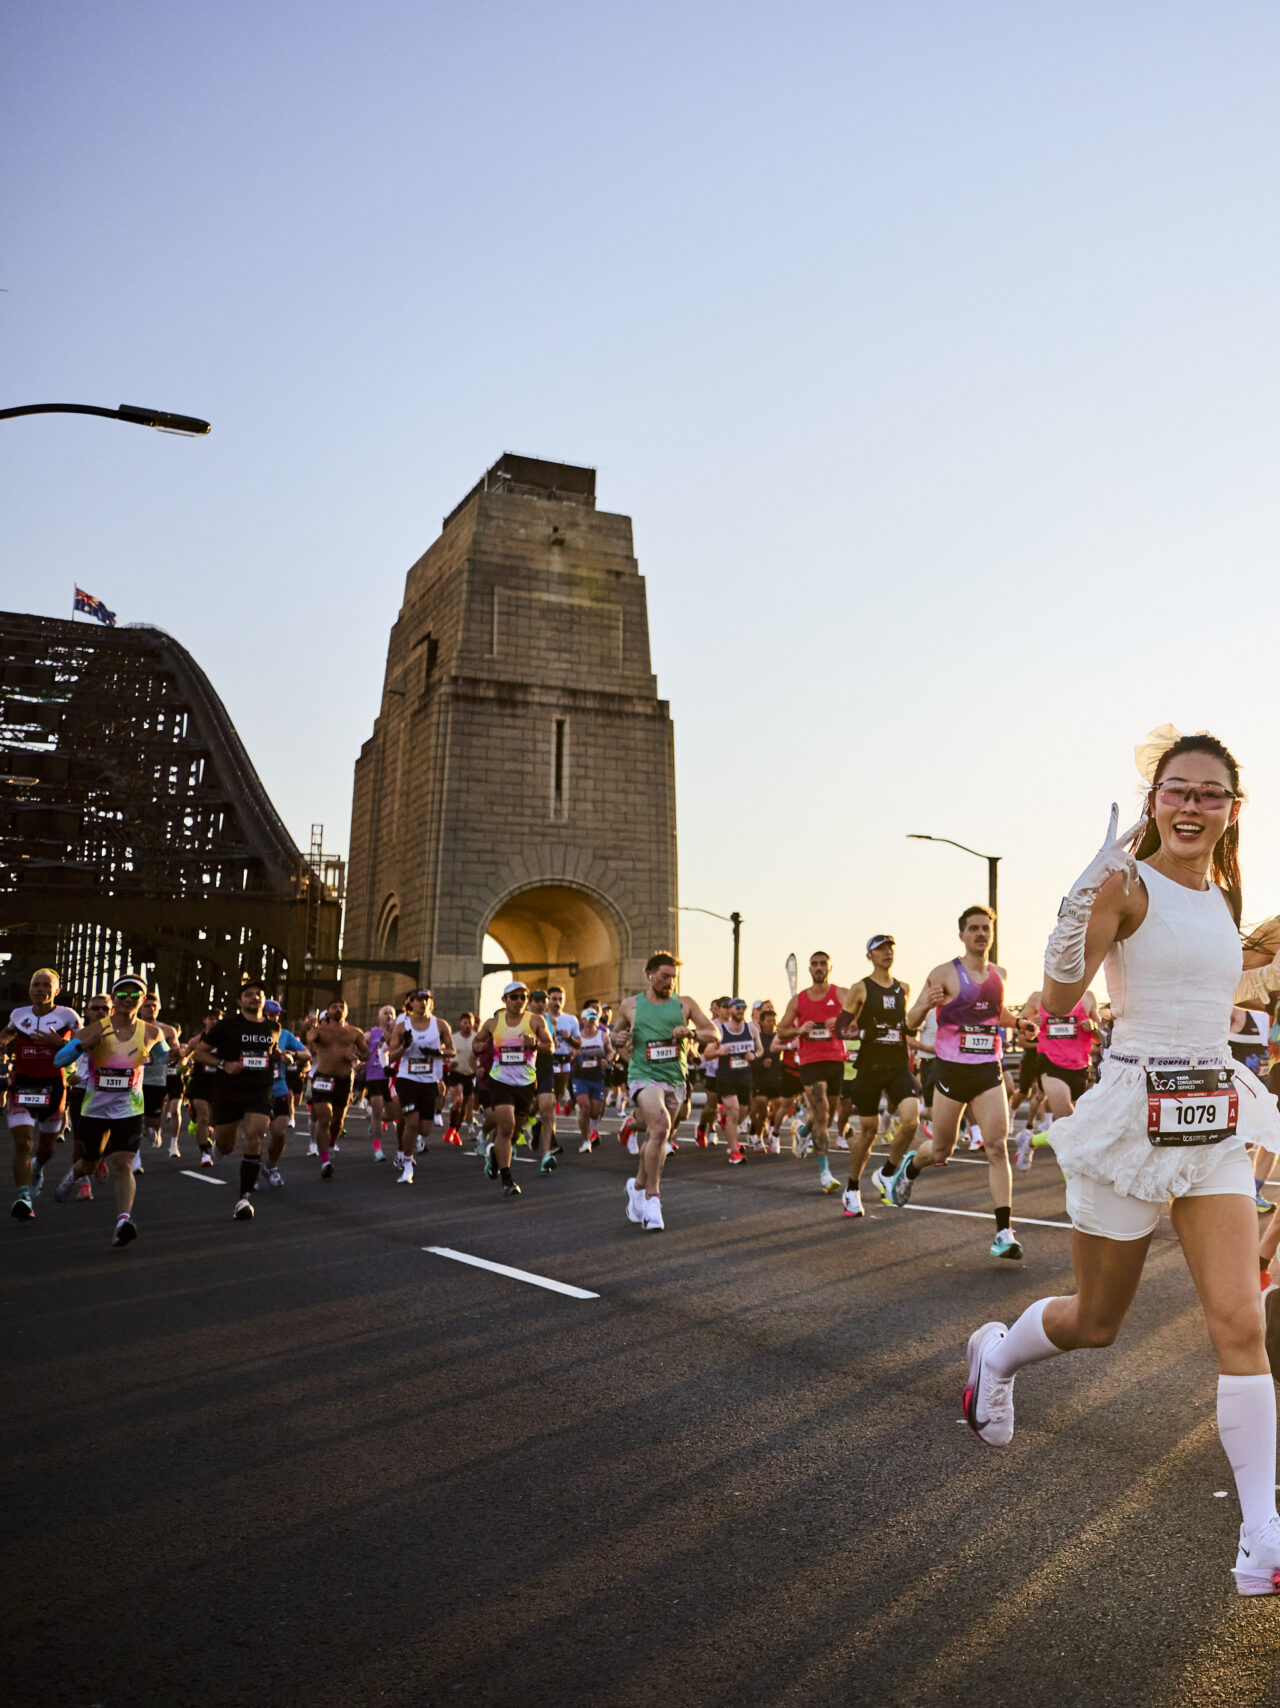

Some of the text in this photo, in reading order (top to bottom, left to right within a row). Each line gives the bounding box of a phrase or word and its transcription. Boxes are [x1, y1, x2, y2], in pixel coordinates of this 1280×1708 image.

[241, 1034, 273, 1044] DIEGO
[972, 1038, 989, 1047] 1377
[1152, 1112, 1156, 1121] 1
[1176, 1104, 1216, 1125] 1079
[1229, 1108, 1236, 1117] A
